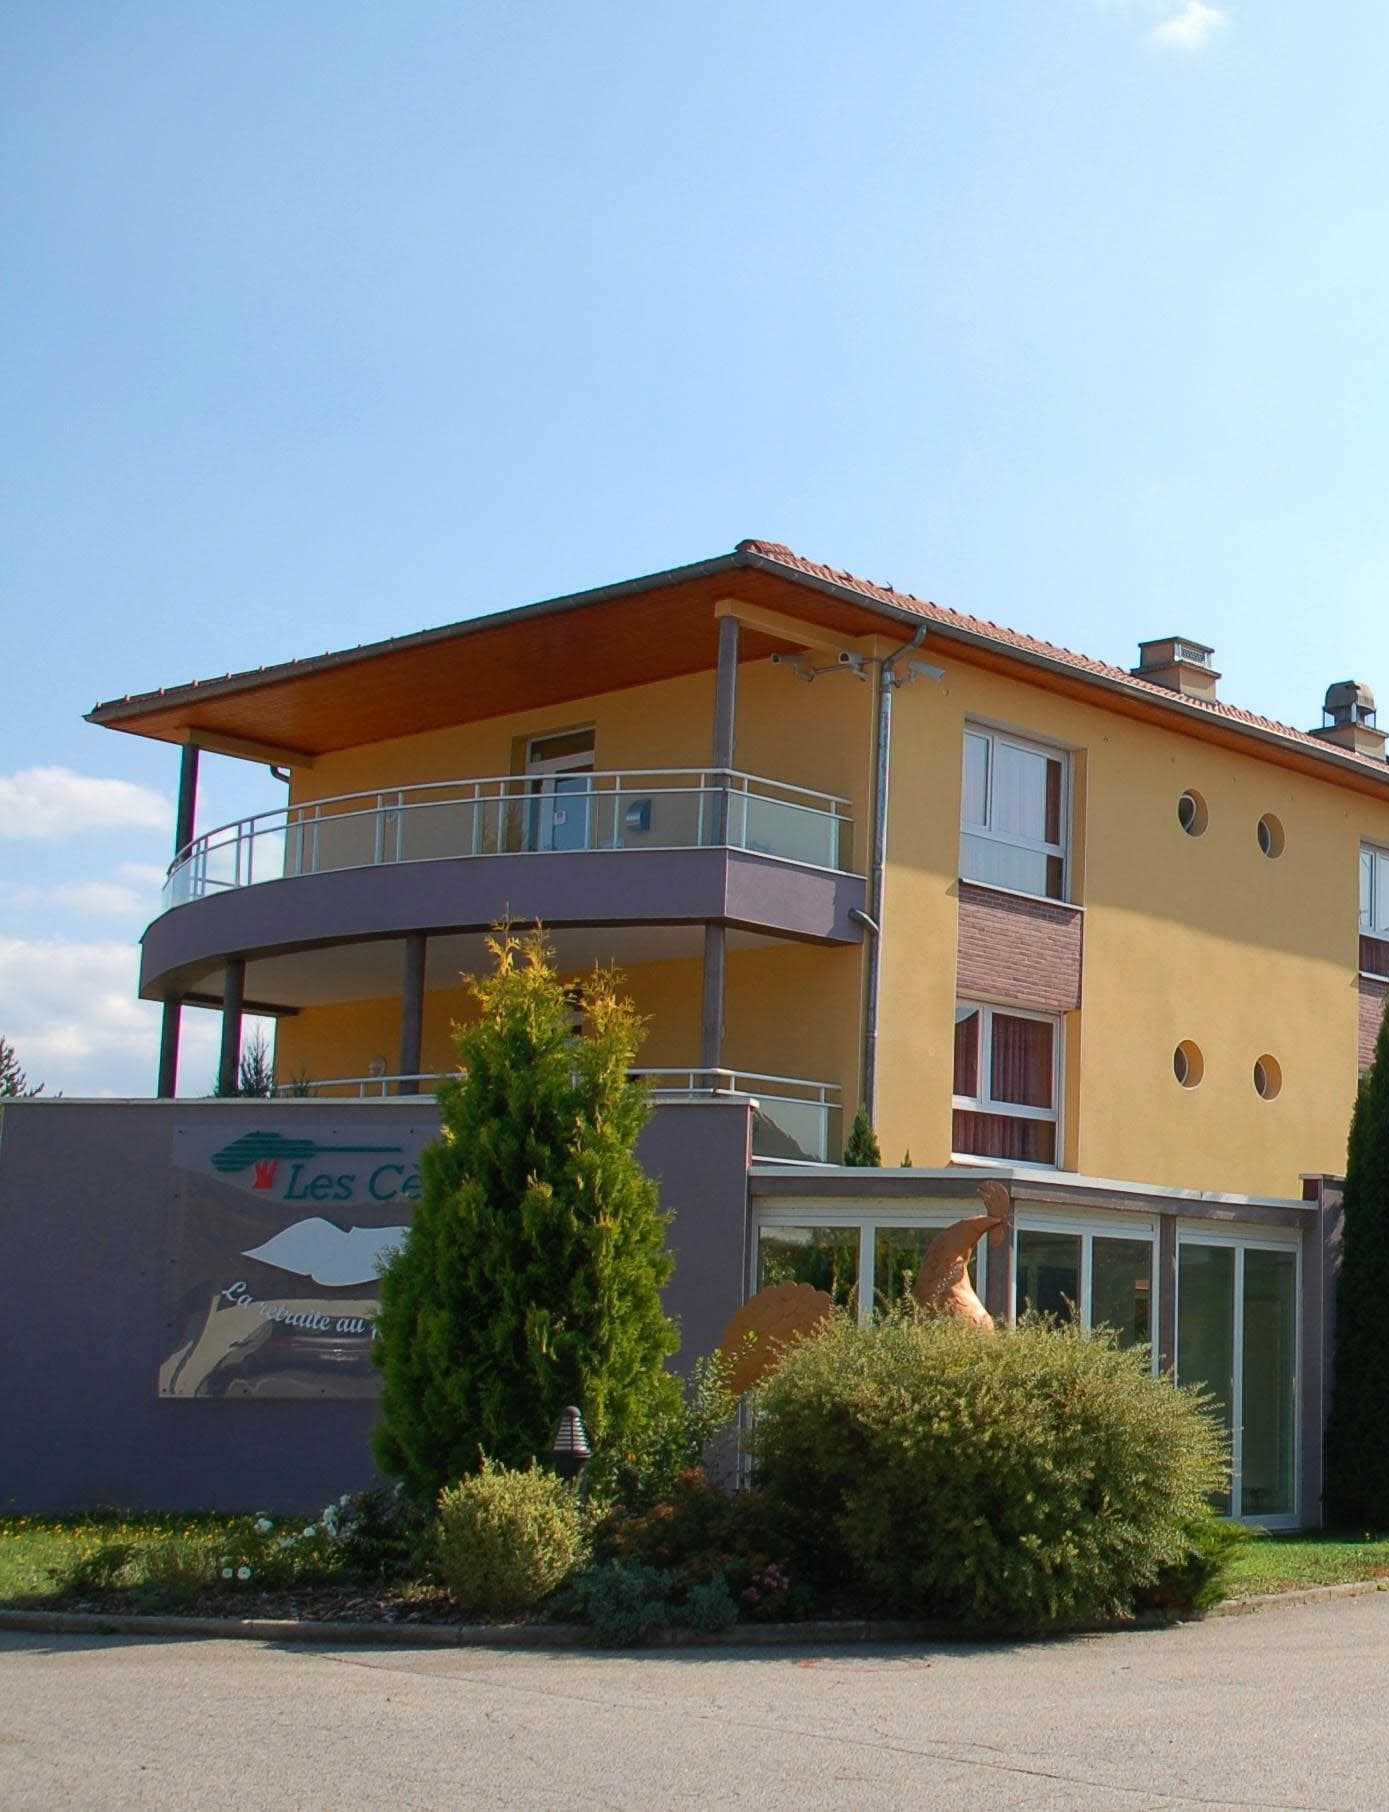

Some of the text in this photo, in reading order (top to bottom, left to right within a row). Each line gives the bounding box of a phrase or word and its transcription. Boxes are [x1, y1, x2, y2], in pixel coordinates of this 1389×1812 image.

[283, 1163, 422, 1200] Les Cè
[222, 1281, 254, 1309] La
[259, 1302, 330, 1331] retraite
[335, 1316, 366, 1333] au
